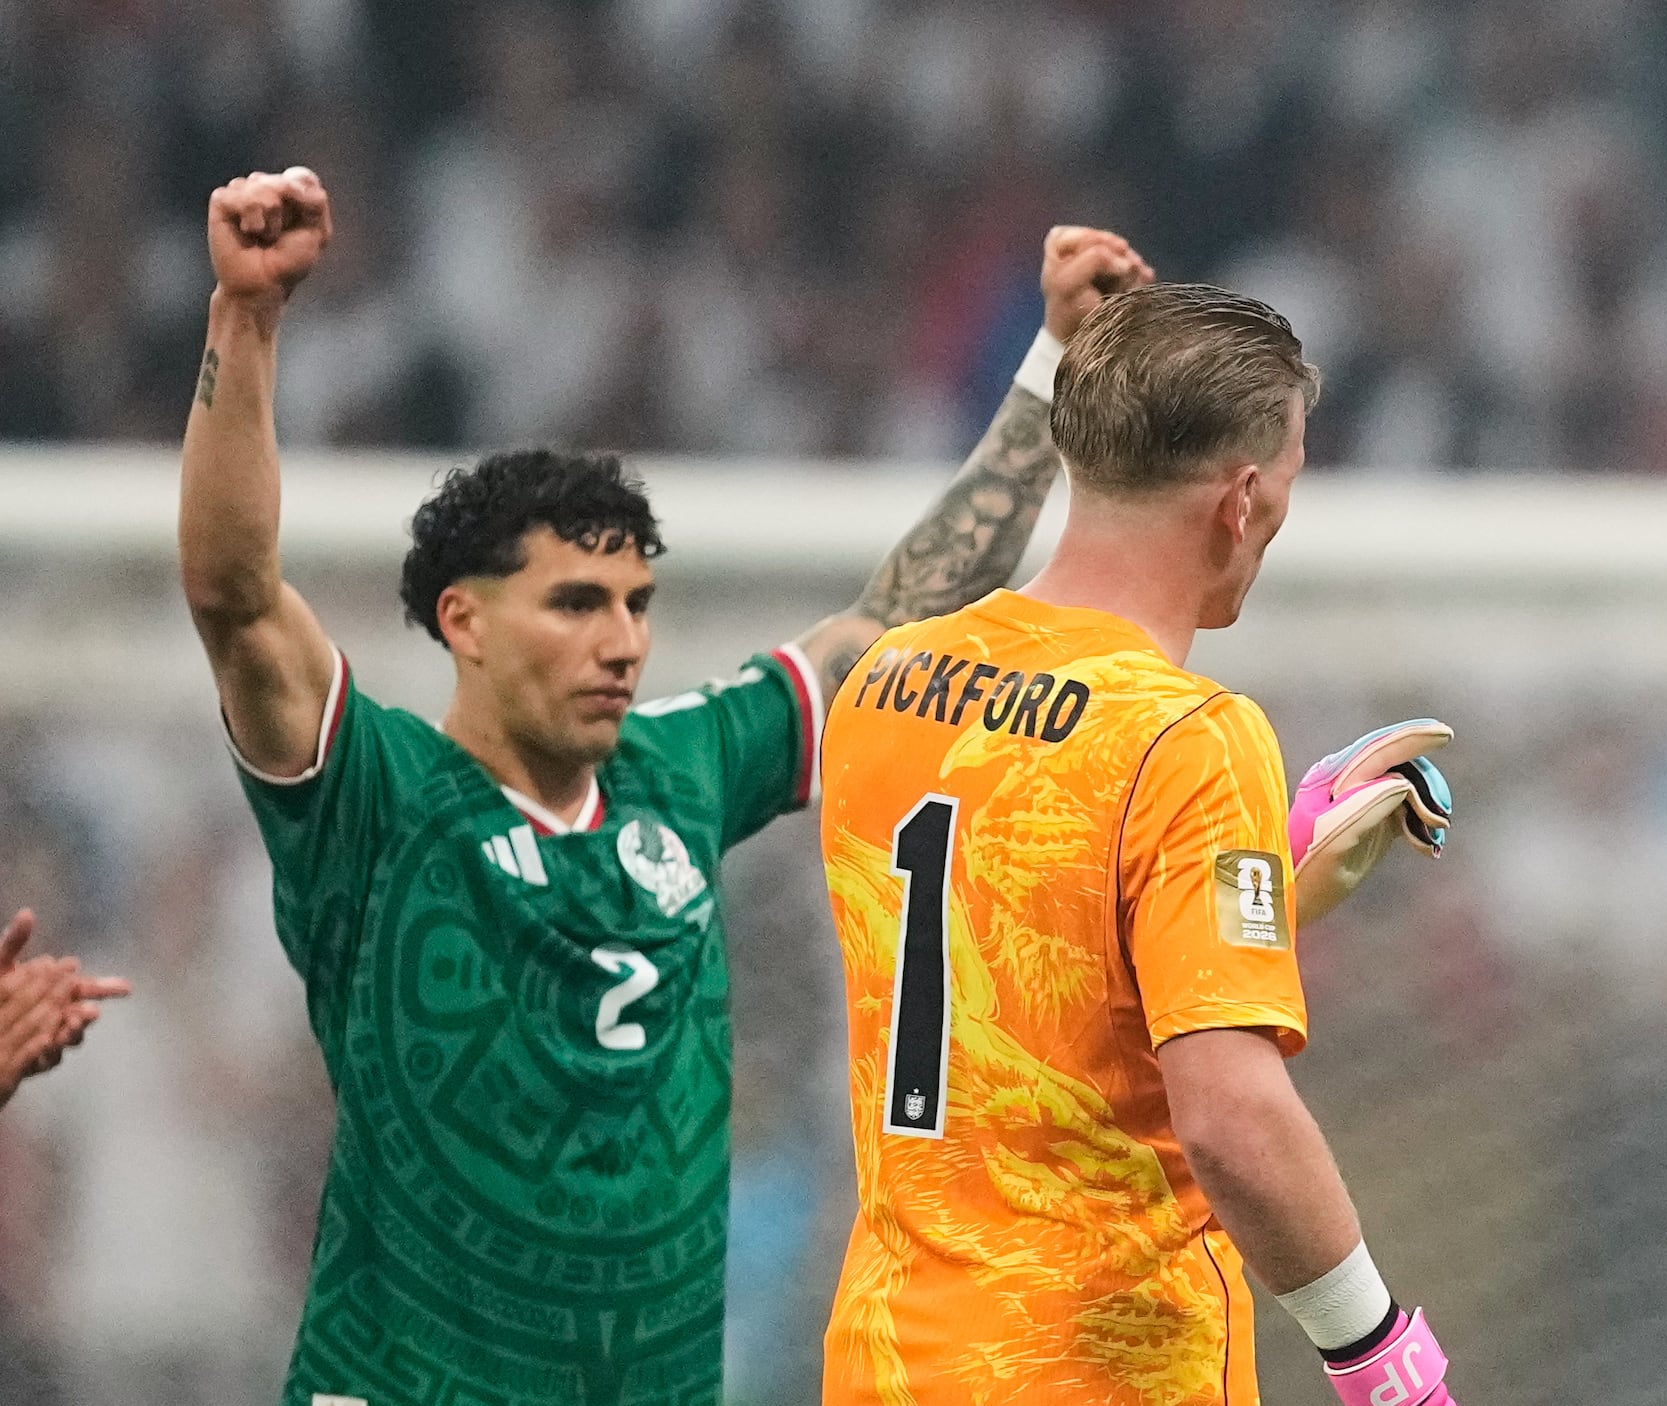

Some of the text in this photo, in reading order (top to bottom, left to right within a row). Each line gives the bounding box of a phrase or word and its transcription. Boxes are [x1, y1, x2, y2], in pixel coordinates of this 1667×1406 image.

[855, 648, 1090, 743] PICKFORD
[1242, 929, 1277, 942] 2026
[1251, 908, 1267, 916] FIFA
[590, 945, 659, 1050] 2
[882, 793, 959, 1138] 1
